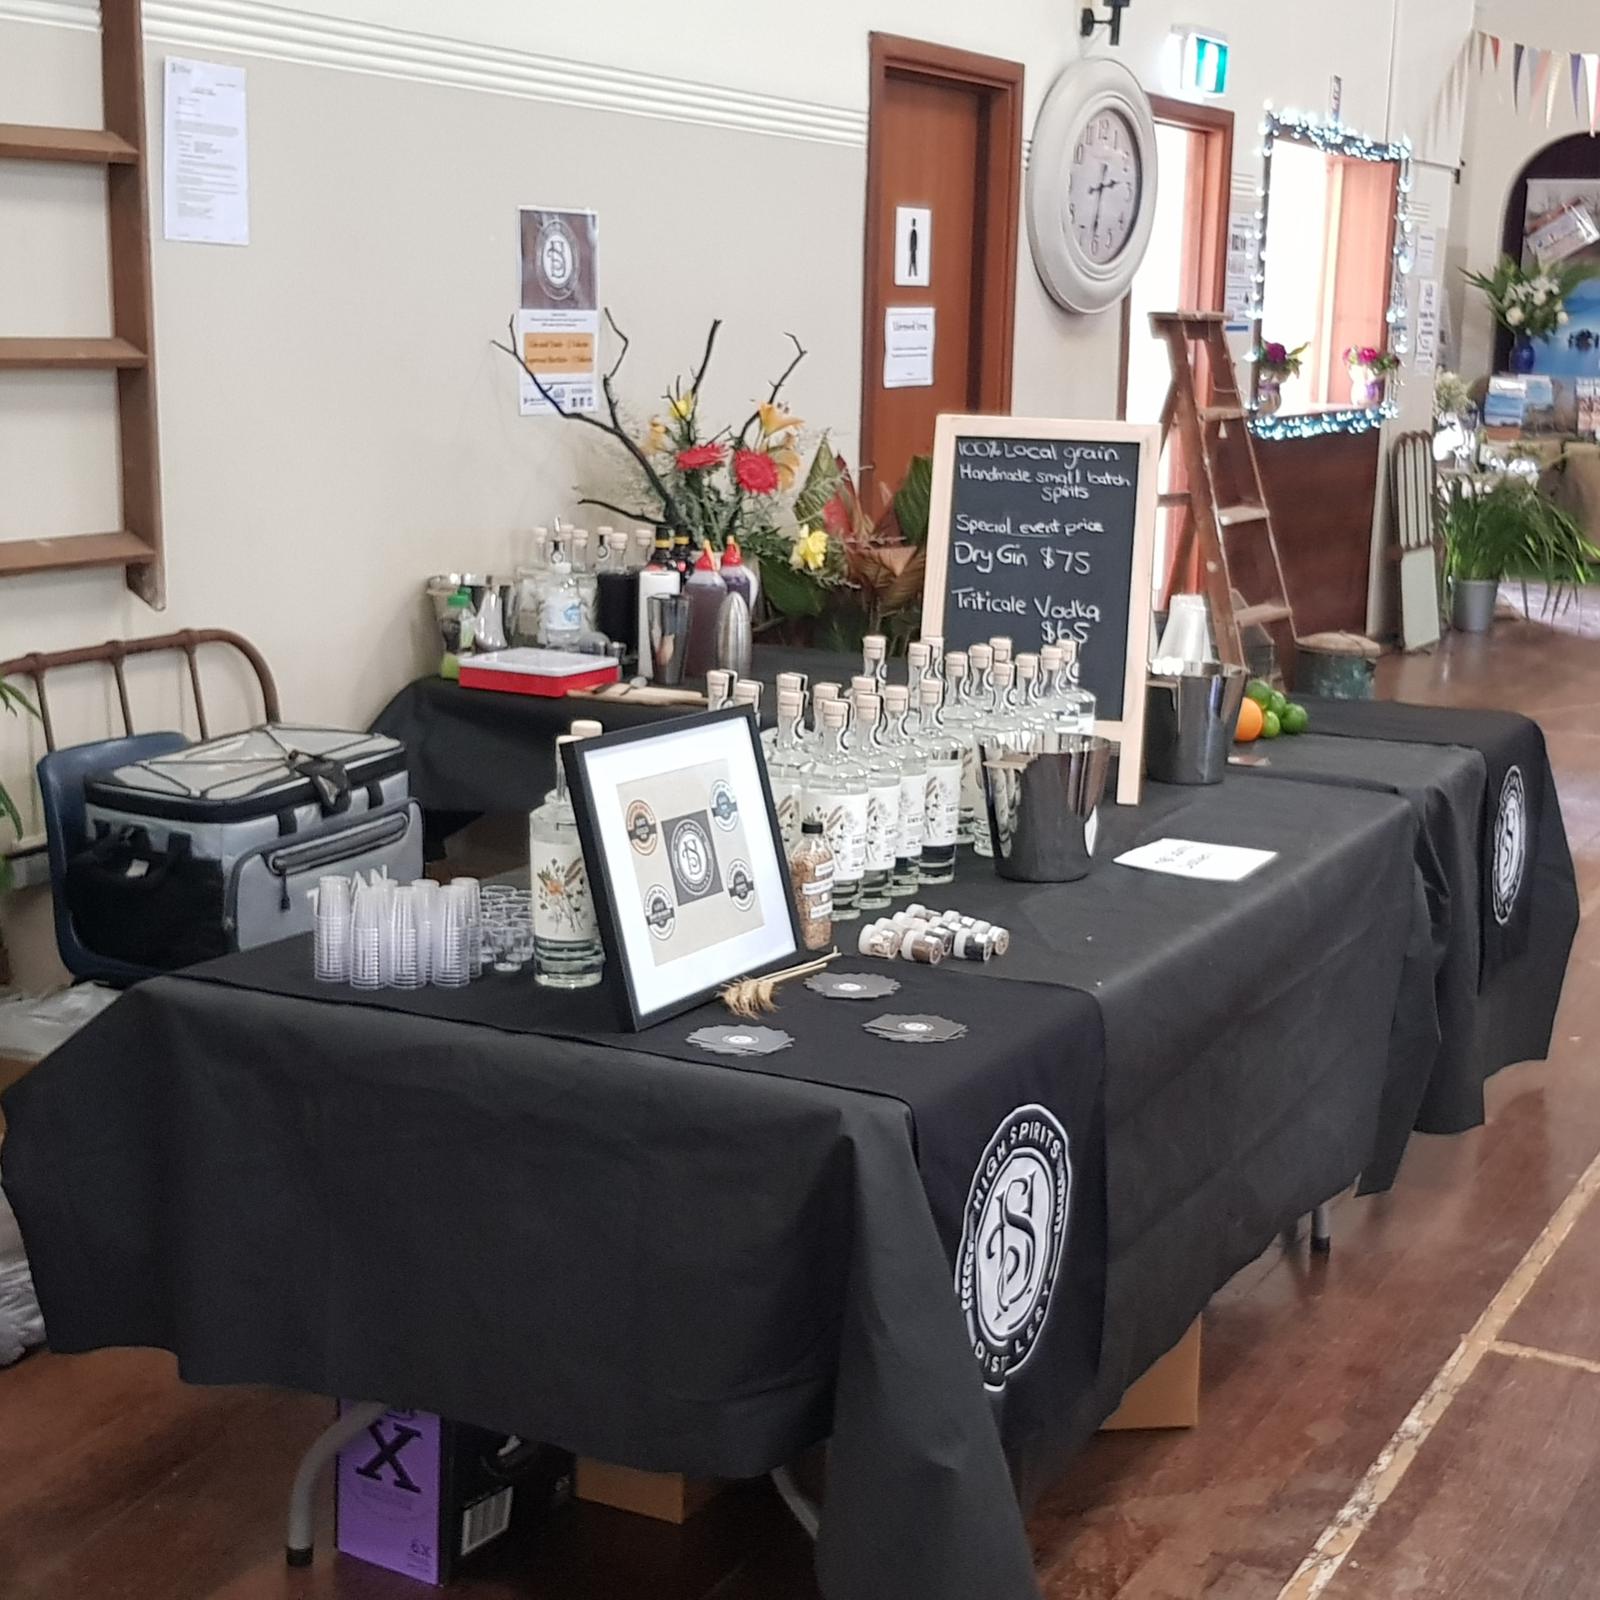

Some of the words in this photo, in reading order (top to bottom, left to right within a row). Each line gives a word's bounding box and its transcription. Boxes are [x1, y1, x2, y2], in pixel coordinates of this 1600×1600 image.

[958, 440, 1001, 459] 100%
[1004, 443, 1058, 461] Local
[1063, 446, 1120, 470] grain
[959, 463, 1032, 483] Handmade
[1035, 468, 1081, 485] small
[1087, 470, 1132, 487] batch
[956, 514, 1011, 535] Special
[1019, 518, 1061, 534] event
[1064, 518, 1104, 537] price
[953, 541, 993, 573] Dry
[996, 544, 1028, 567] Gin
[1040, 545, 1091, 575] $75
[951, 587, 1027, 615] Triticale
[1033, 594, 1101, 622] Vodka
[1041, 620, 1091, 643] $65
[972, 1139, 1008, 1210] HIGH
[1009, 1121, 1062, 1159] SPIRITS
